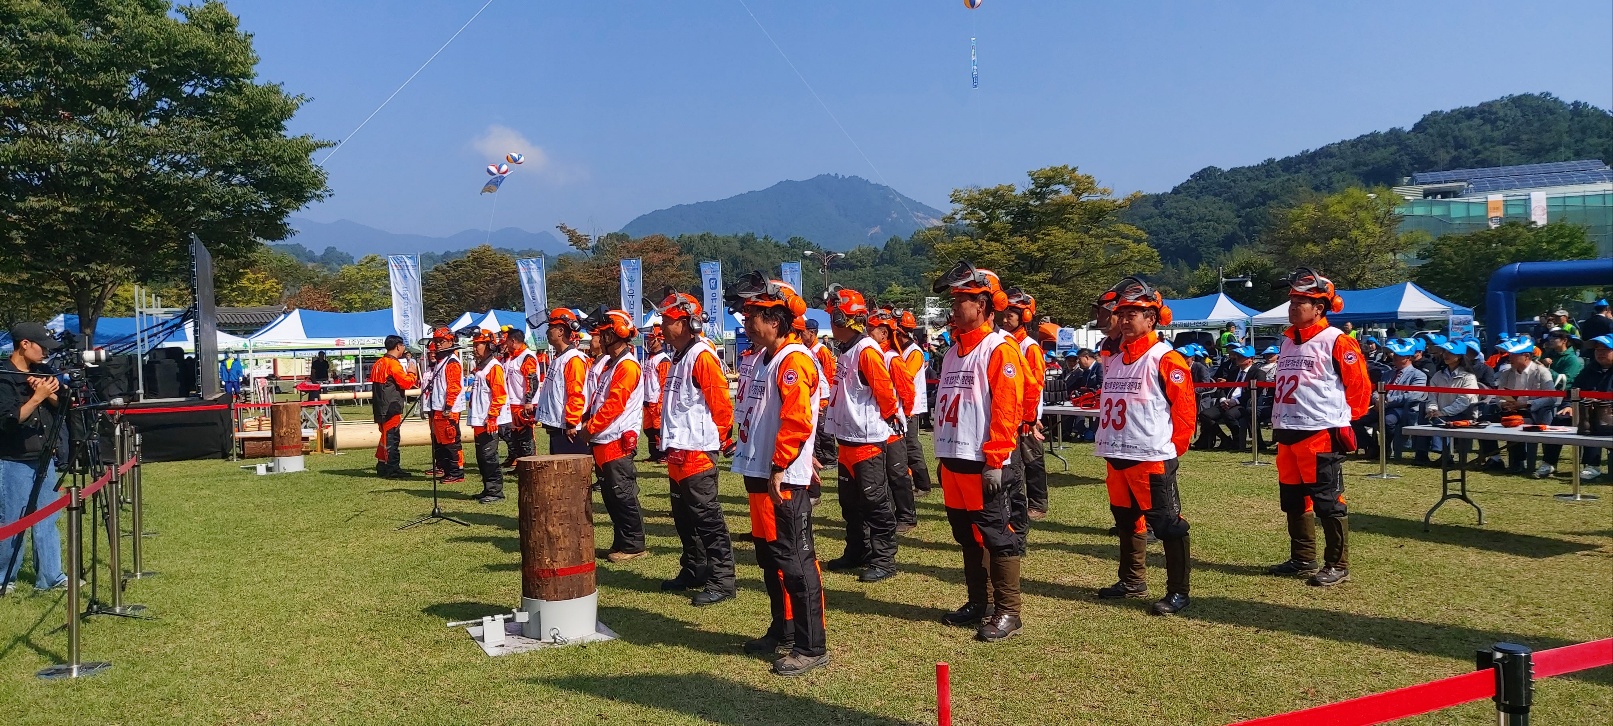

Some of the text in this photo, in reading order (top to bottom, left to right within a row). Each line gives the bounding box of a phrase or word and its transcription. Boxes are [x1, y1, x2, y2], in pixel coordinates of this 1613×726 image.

[1274, 374, 1299, 405] 32
[938, 393, 961, 428] 34
[1101, 397, 1127, 431] 33
